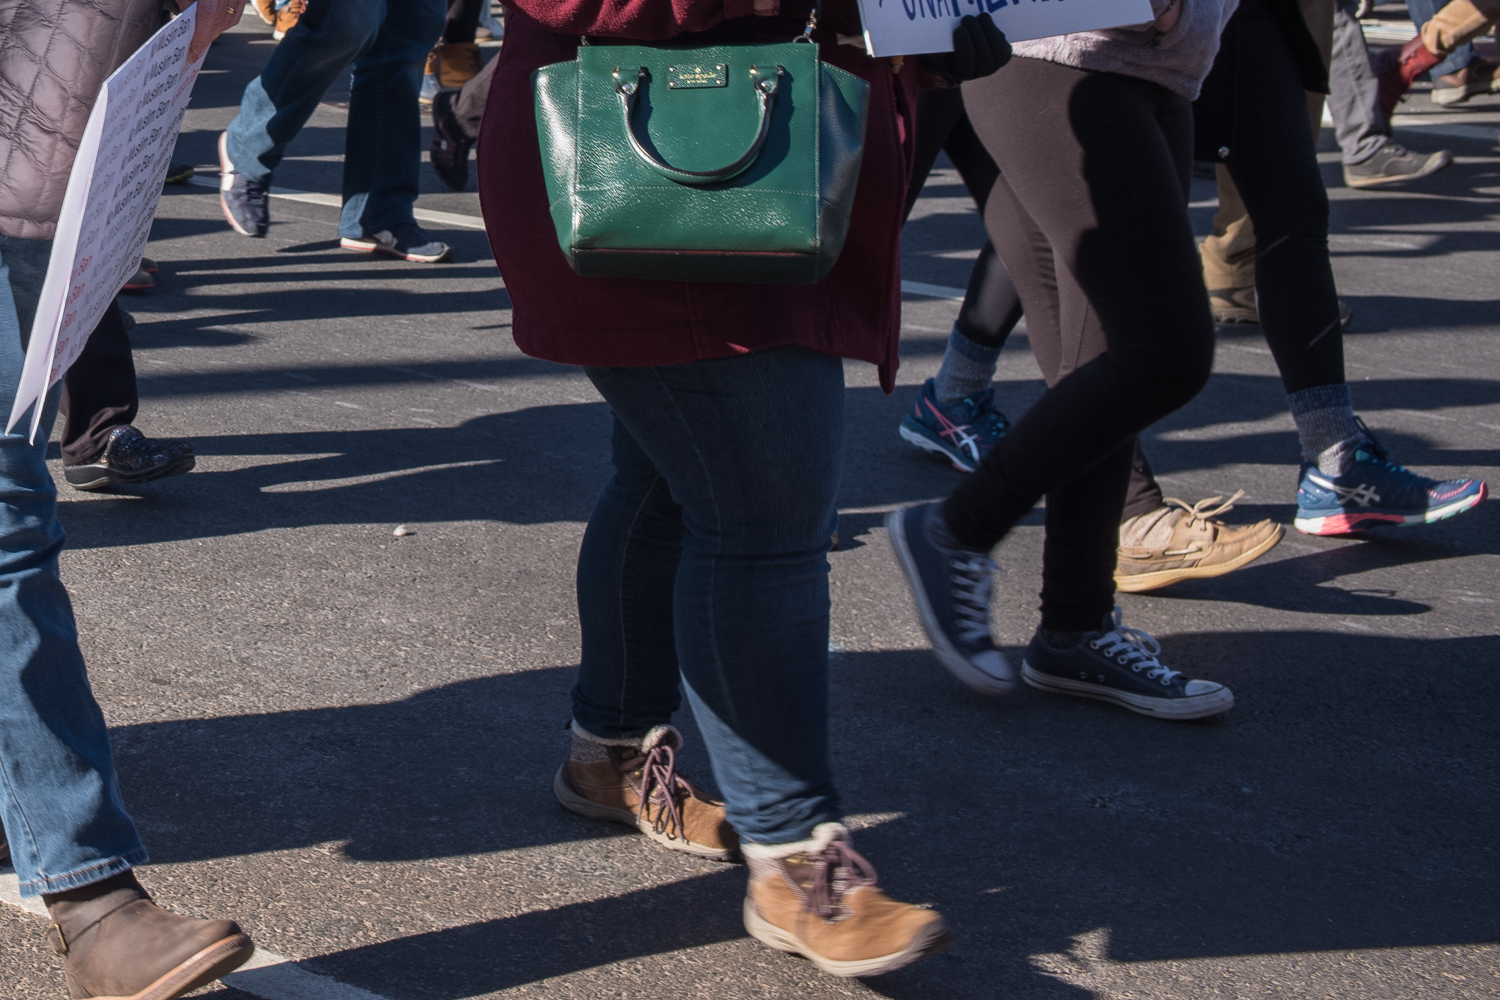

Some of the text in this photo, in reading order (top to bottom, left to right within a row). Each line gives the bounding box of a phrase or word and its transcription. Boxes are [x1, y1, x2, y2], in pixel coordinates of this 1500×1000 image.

[158, 26, 179, 50] Muslim
[177, 17, 191, 38] Ban
[149, 55, 172, 79] Muslim
[170, 47, 185, 65] Ban
[142, 83, 165, 106] Muslim
[163, 73, 178, 91] Ban
[136, 110, 156, 131] Muslim
[155, 100, 170, 118] Ban
[127, 137, 149, 162] Muslim
[147, 127, 163, 145] Ban
[119, 164, 141, 190] Muslim
[139, 153, 155, 172] Ban
[112, 191, 133, 217] Muslim
[132, 179, 147, 198] Ban
